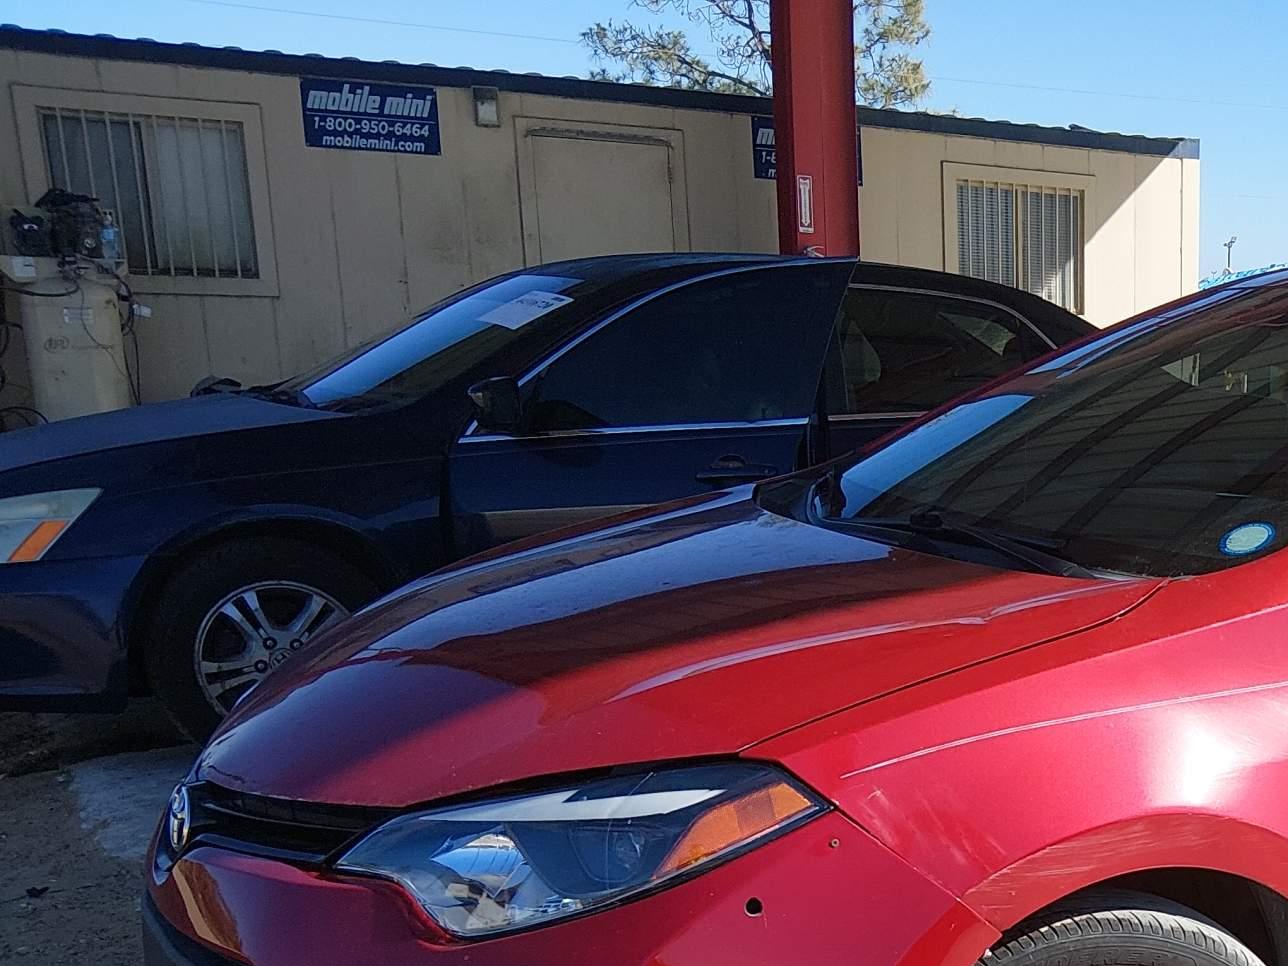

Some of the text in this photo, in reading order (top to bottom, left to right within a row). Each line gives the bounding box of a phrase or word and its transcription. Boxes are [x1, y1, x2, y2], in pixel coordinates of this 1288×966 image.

[306, 84, 433, 118] mobile mini
[313, 116, 429, 138] 1-800-950-6464
[322, 135, 425, 152] mobilemini.com
